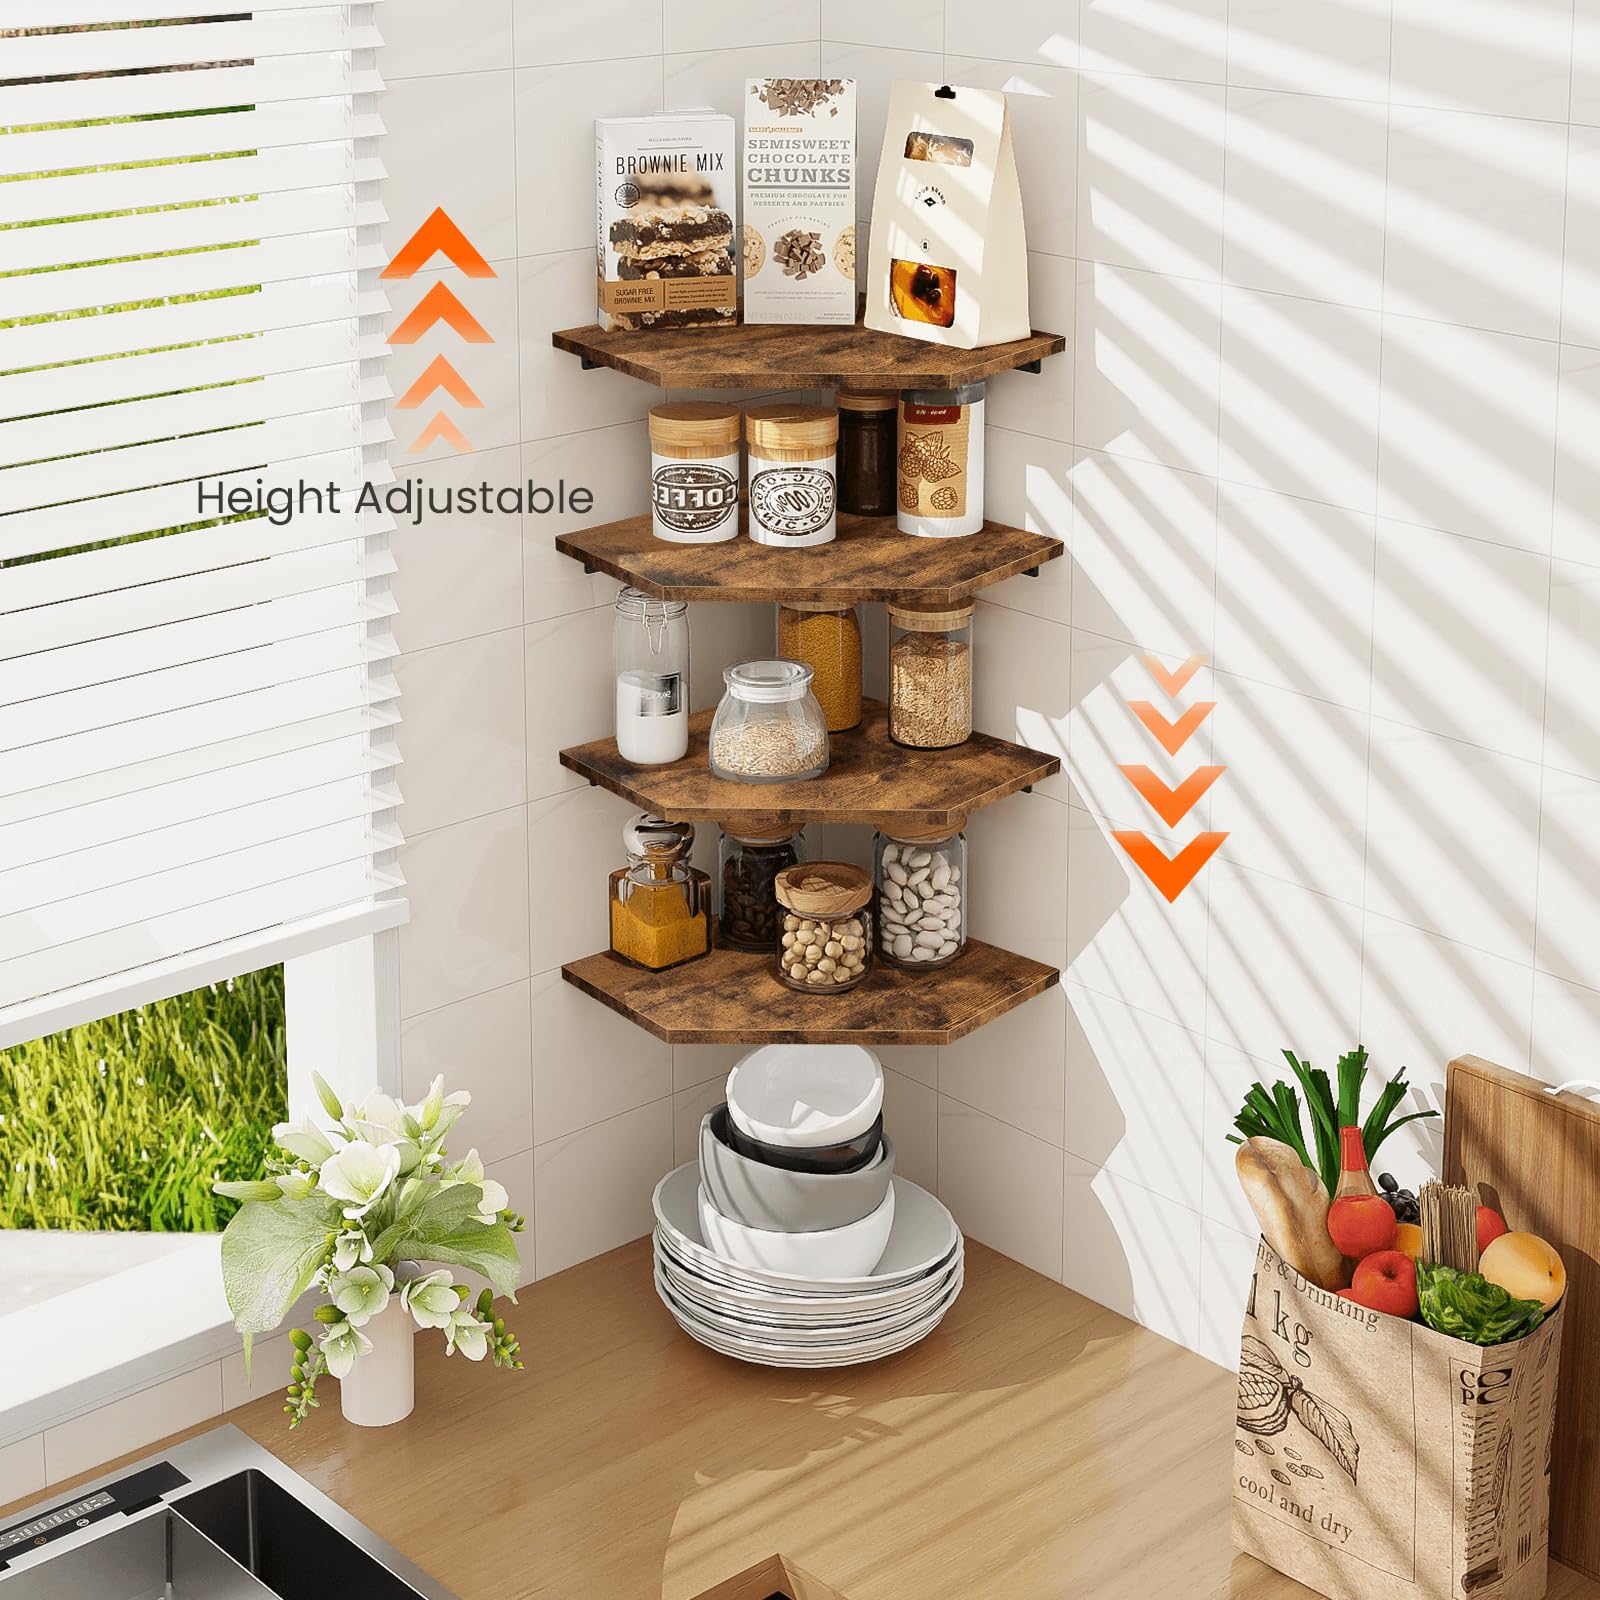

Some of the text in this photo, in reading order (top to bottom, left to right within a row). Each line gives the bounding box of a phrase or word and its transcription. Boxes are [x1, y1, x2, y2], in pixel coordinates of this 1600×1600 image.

[748, 139, 850, 150] SEMISWEET
[616, 152, 724, 175] BROWNIE MIX
[748, 154, 850, 164] CHOCOLATE
[748, 168, 850, 183] CHUNKS
[1278, 1260, 1289, 1280] &
[1293, 1272, 1380, 1333] Drinking
[1272, 1290, 1314, 1368] kg
[1240, 1476, 1353, 1544] cool and dry
